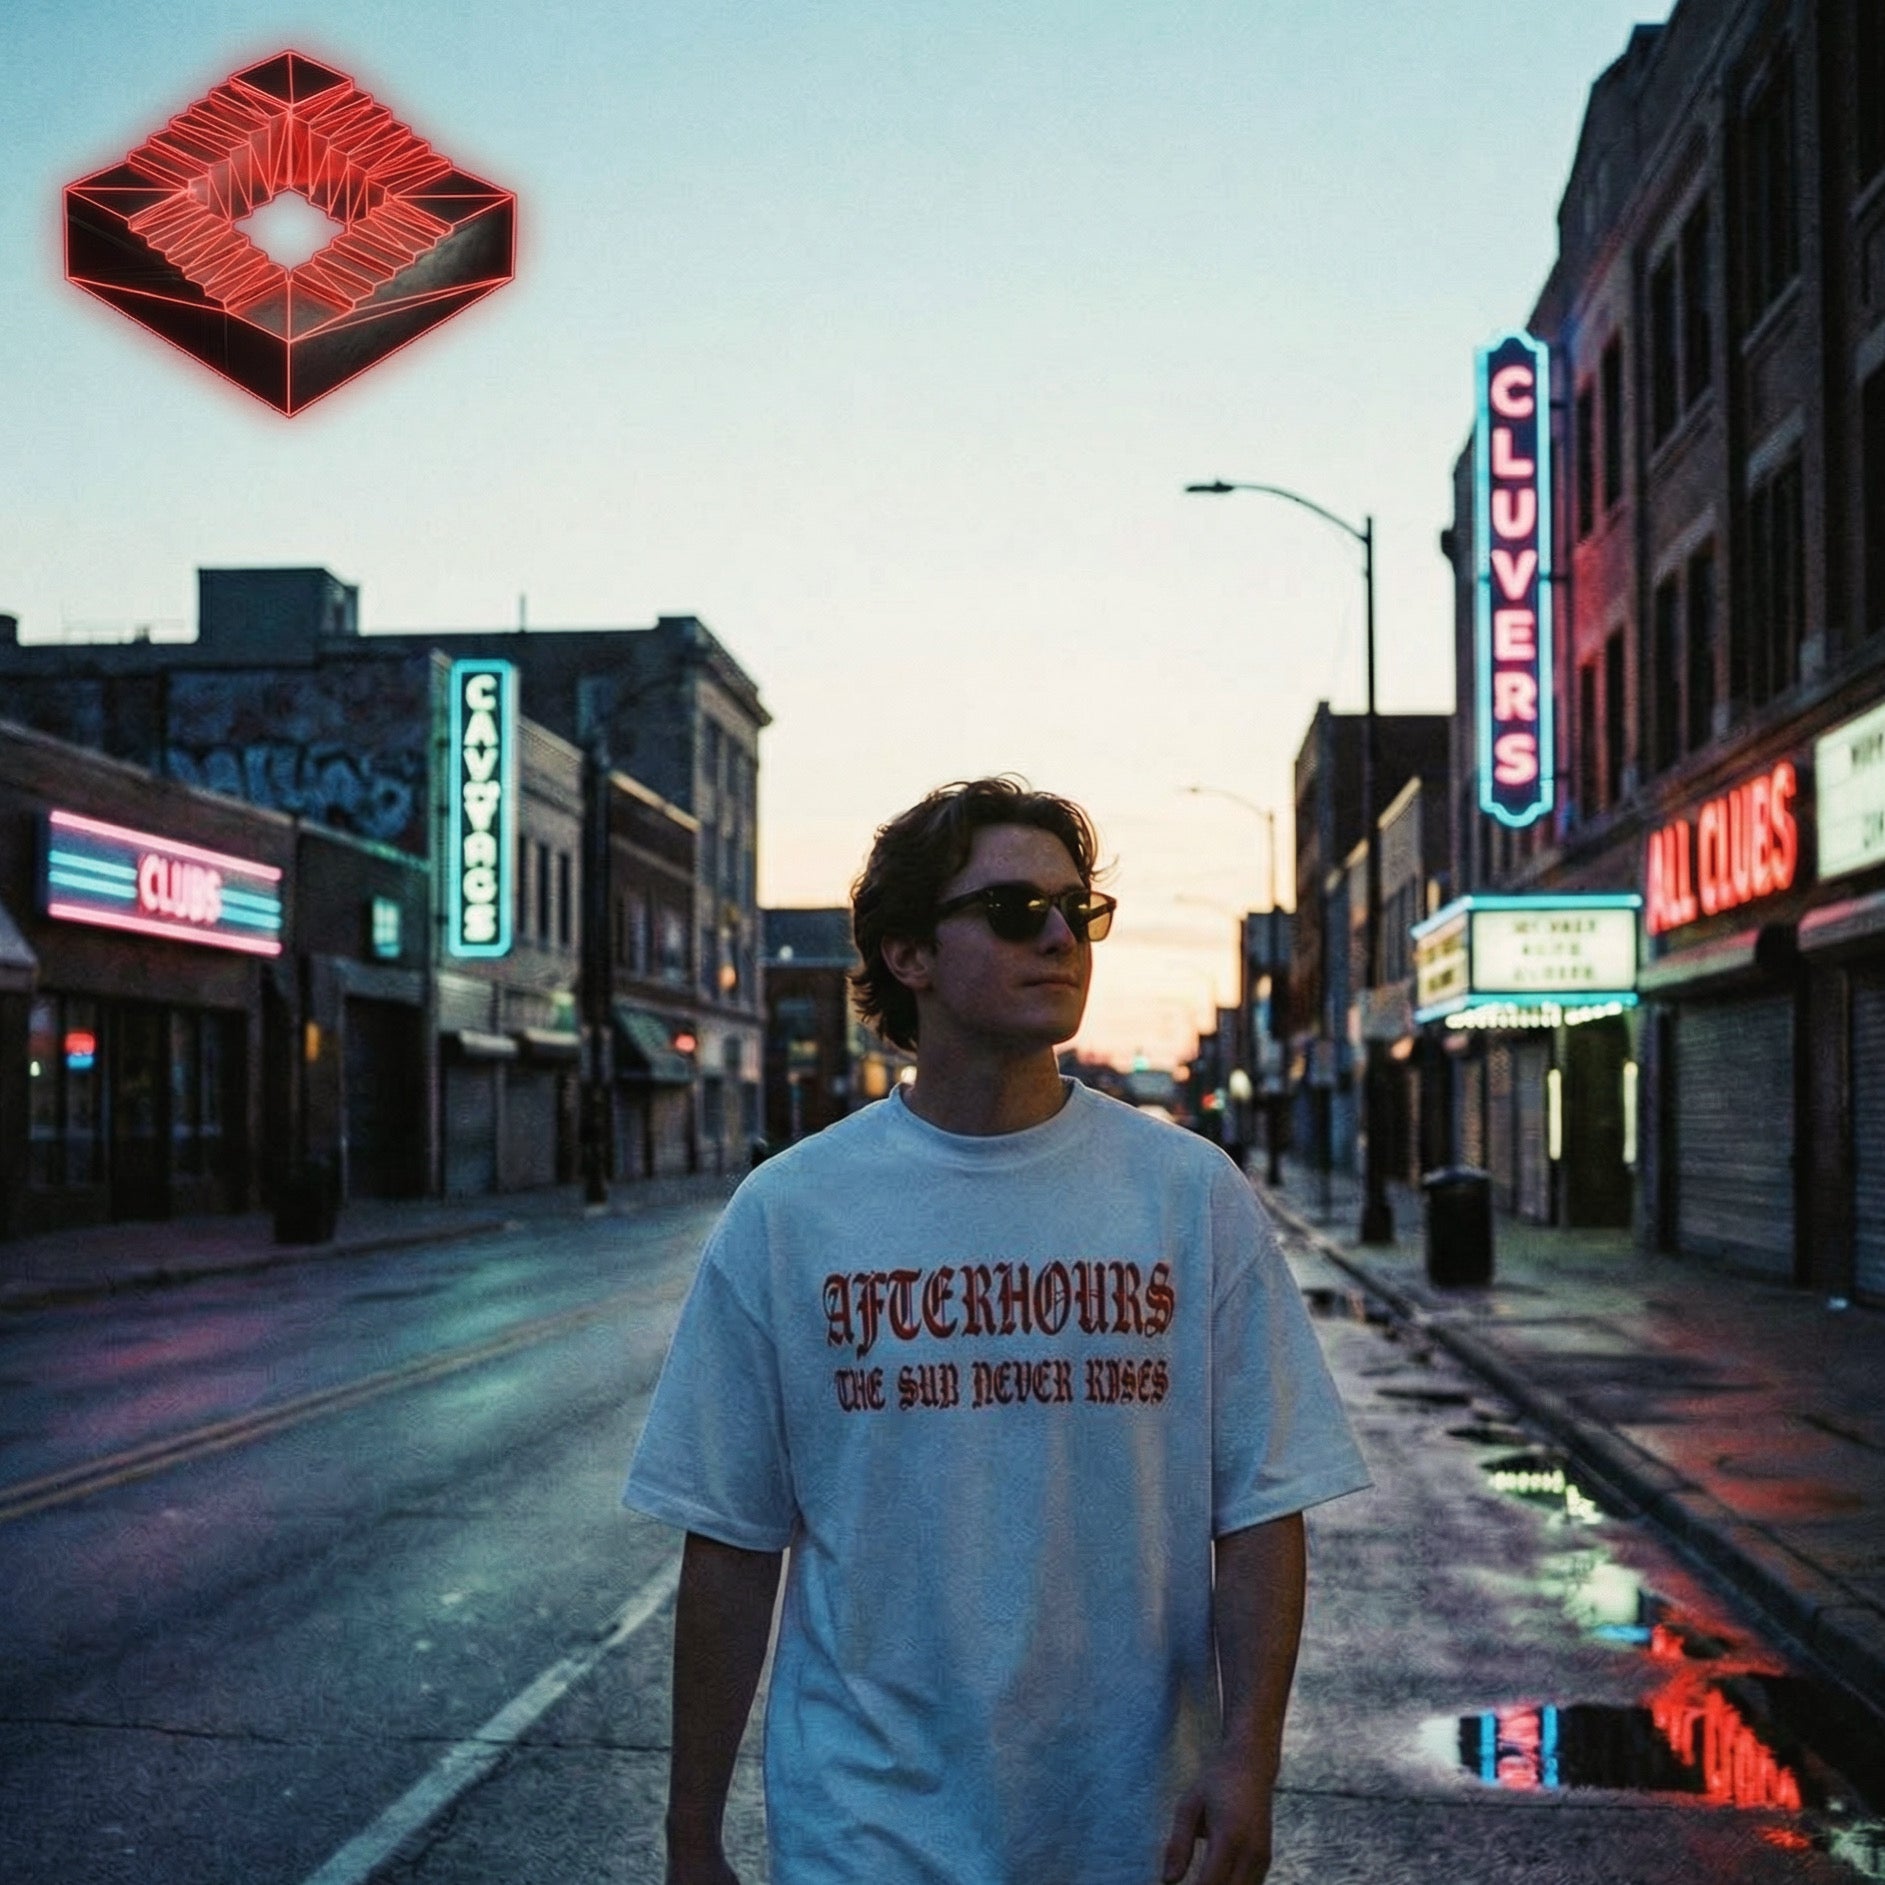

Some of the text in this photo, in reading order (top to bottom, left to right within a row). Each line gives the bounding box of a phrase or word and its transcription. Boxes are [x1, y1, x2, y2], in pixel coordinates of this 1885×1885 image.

[1490, 364, 1539, 786] CLUVERS
[823, 1259, 1175, 1360] AFTERHOURS
[835, 1366, 886, 1412] THE
[971, 1358, 1074, 1409] NEVER
